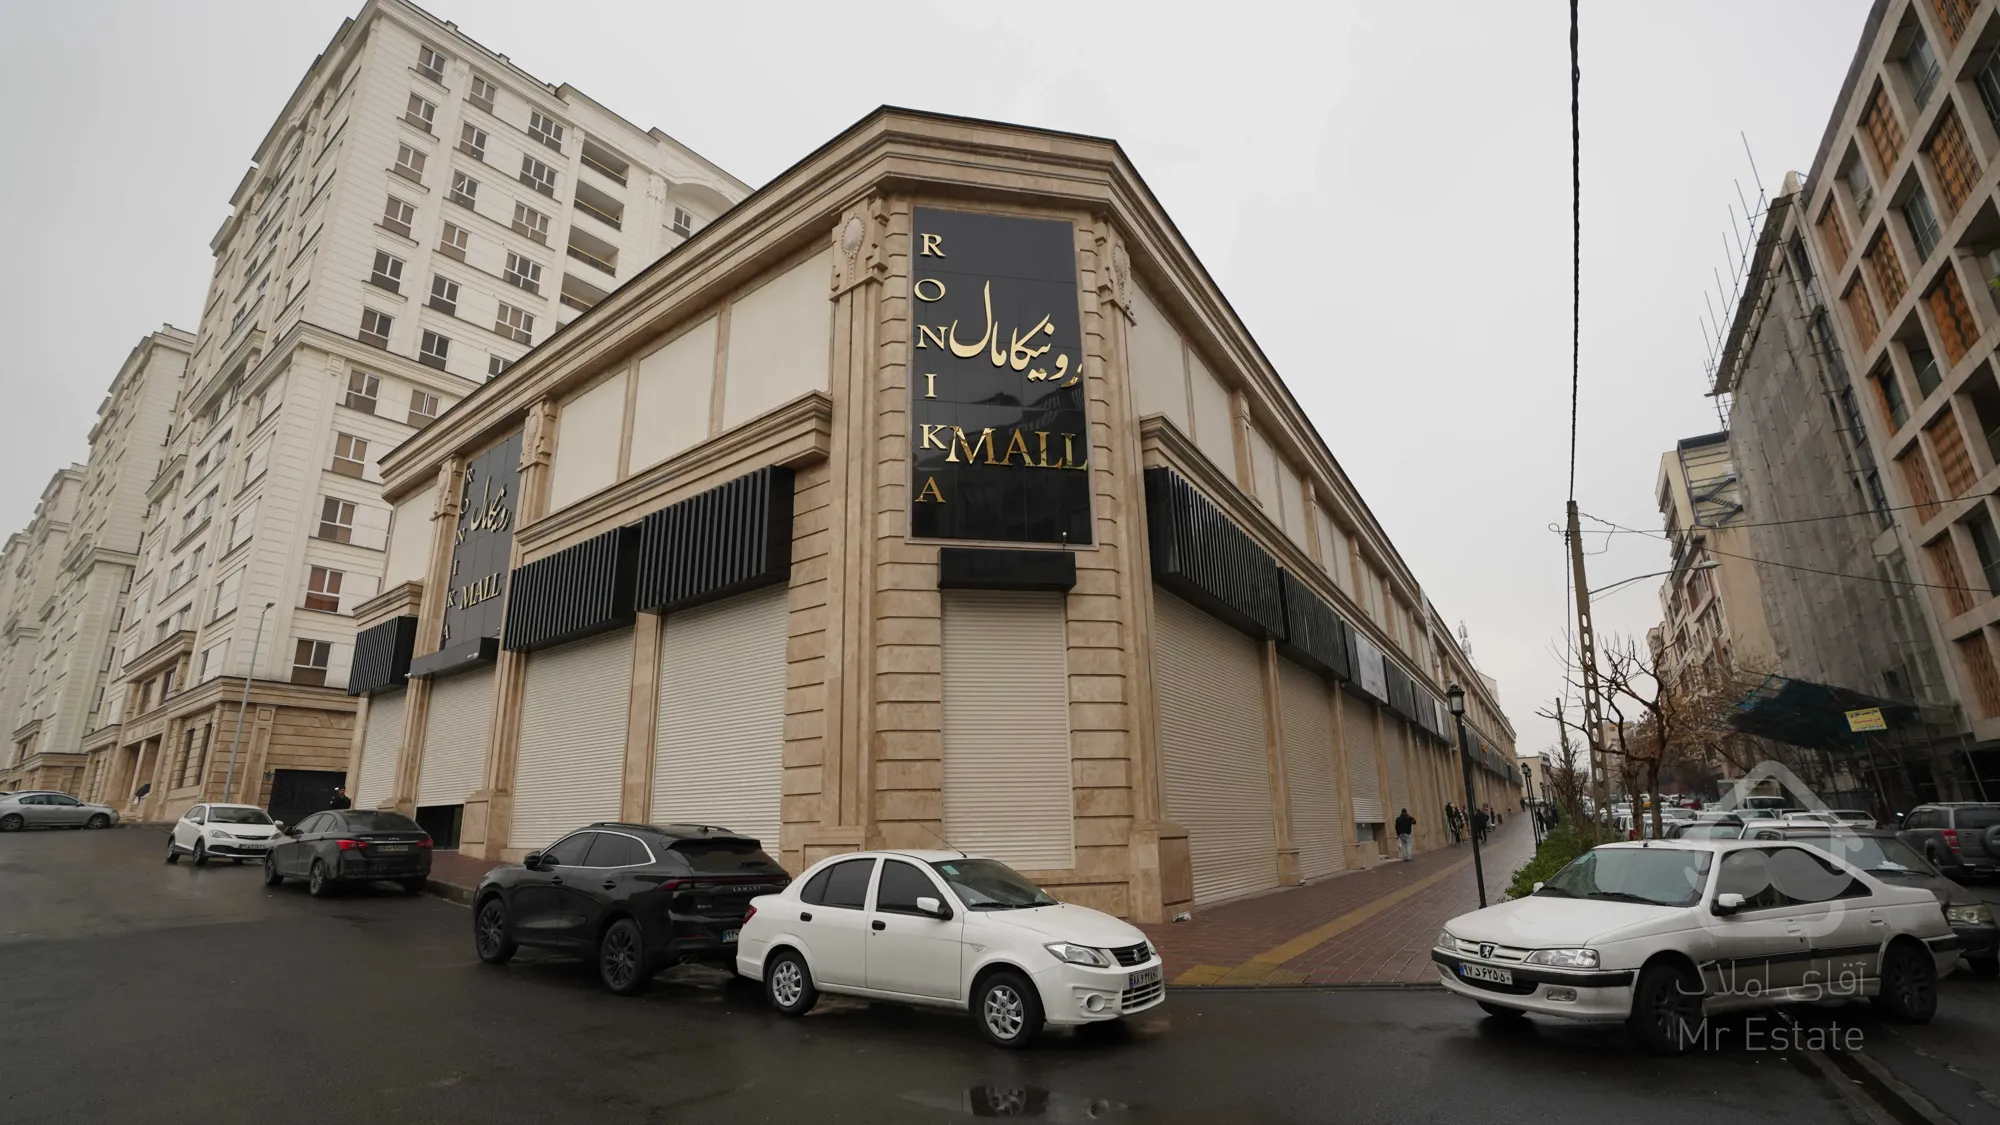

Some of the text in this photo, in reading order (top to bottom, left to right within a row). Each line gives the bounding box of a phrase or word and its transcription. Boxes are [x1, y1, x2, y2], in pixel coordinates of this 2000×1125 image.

[913, 233, 948, 503] RONIKA
[945, 425, 1088, 472] MALL
[459, 572, 502, 611] MALL
